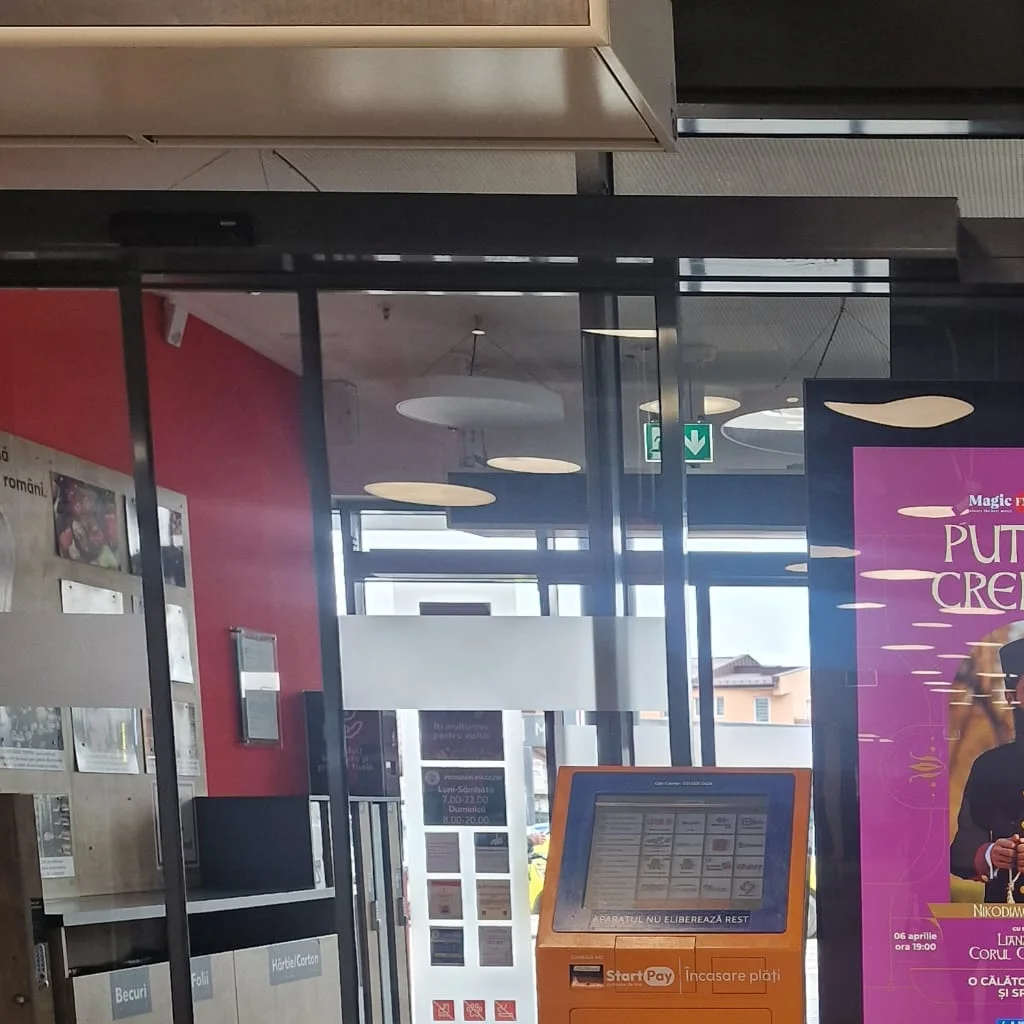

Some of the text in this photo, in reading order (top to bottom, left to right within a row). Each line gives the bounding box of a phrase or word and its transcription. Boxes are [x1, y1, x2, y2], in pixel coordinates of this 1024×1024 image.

[968, 493, 1013, 510] Magic
[591, 912, 749, 925] APARATUL NU ELIBEREAZĂ REST
[893, 931, 938, 942] 06 aprilie
[912, 942, 937, 951] 19:00
[968, 946, 1012, 961] CORUL
[684, 965, 746, 981] Încasare
[967, 976, 978, 987] O
[115, 983, 148, 1005] Becuri
[997, 987, 1010, 1000] ȘI
